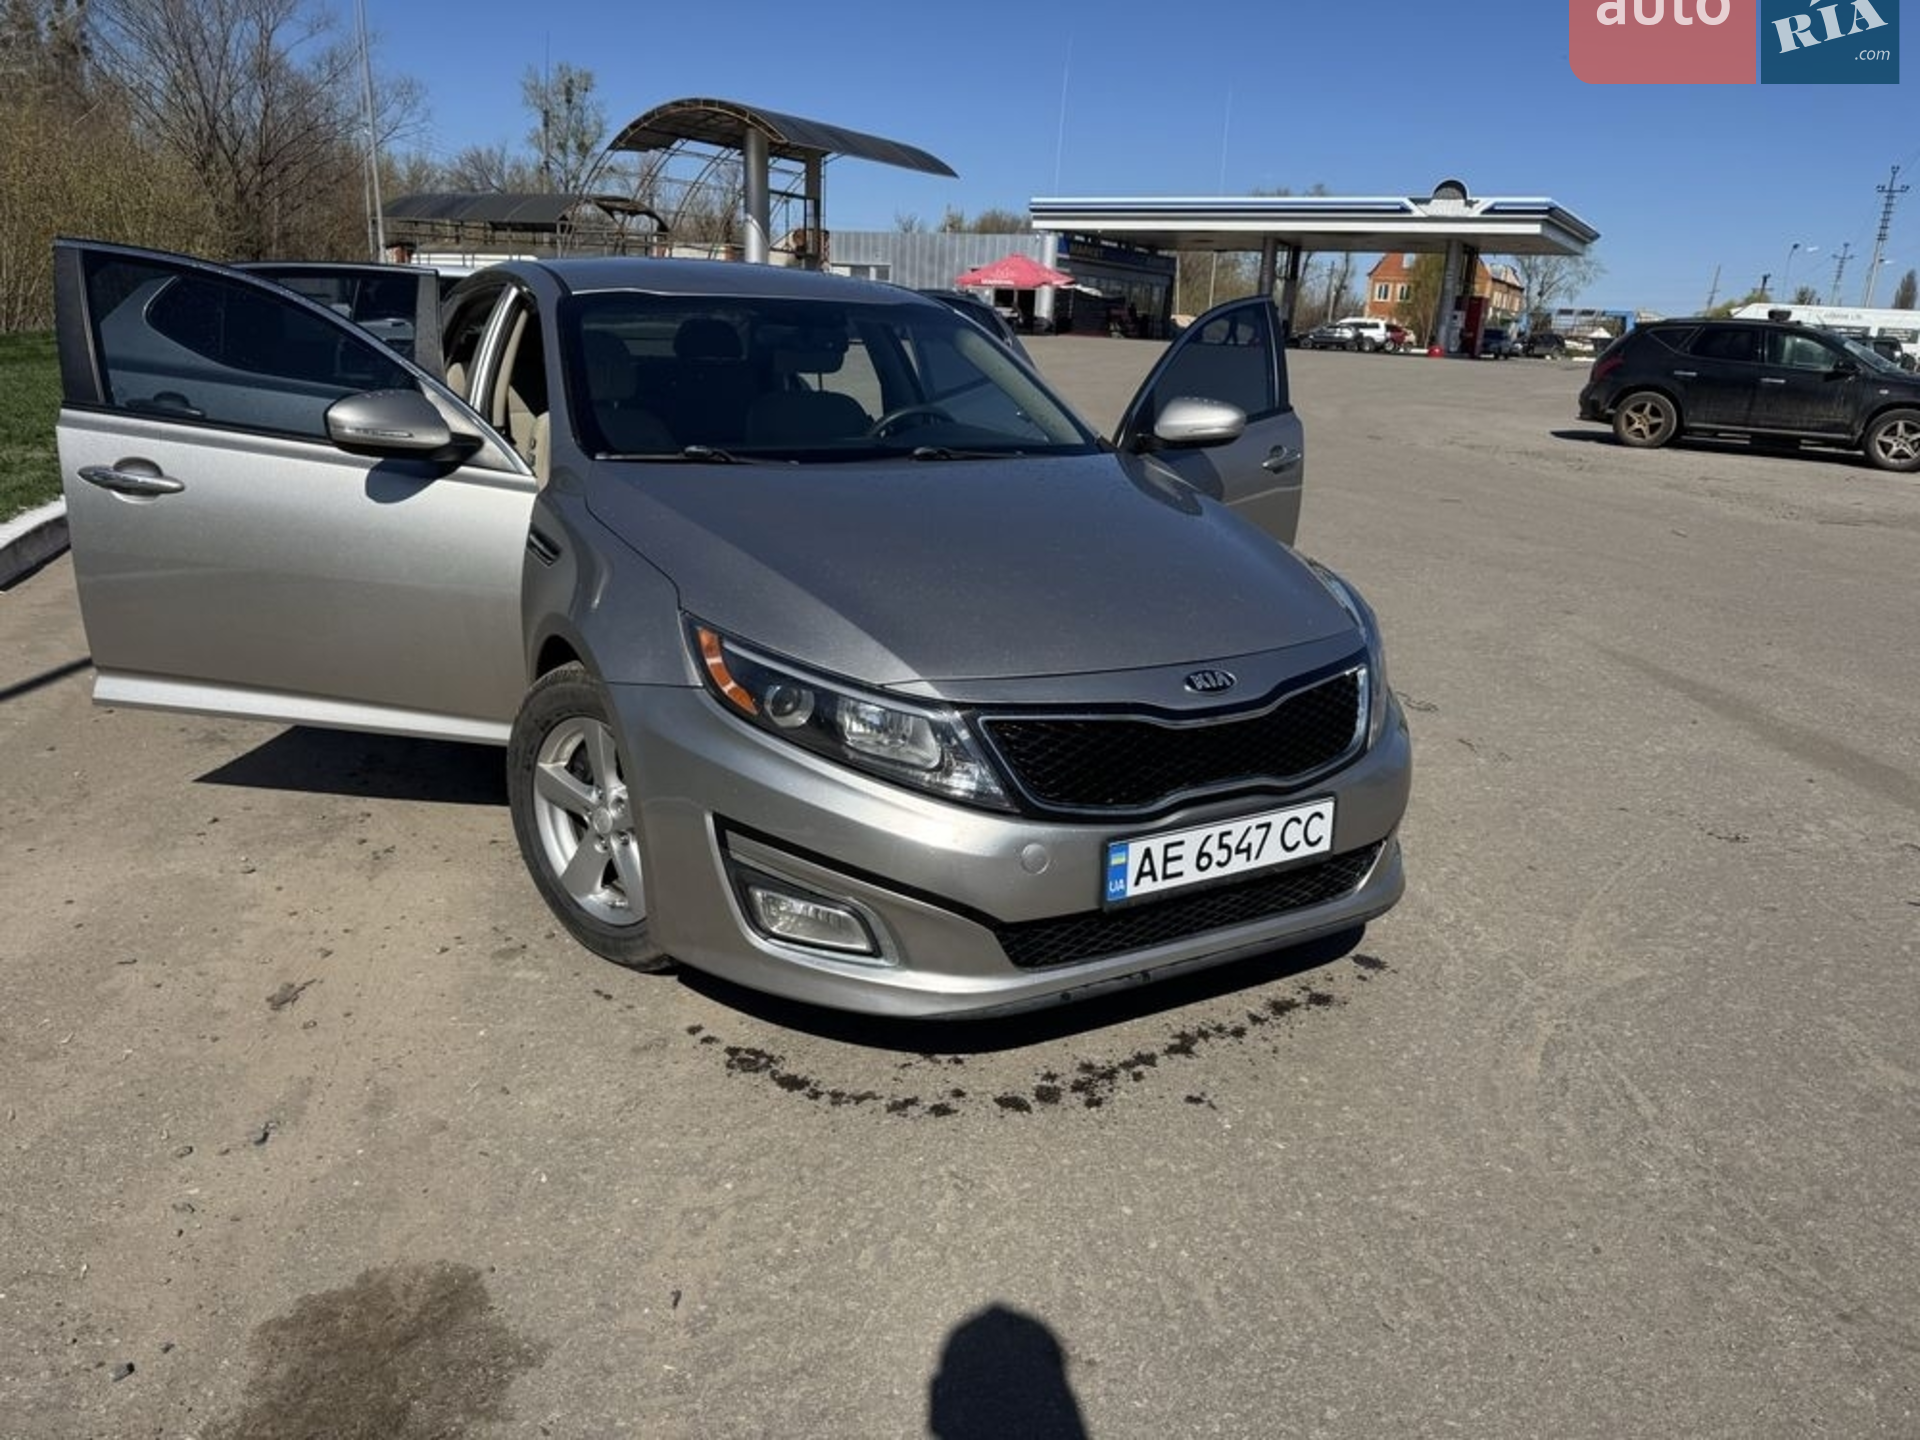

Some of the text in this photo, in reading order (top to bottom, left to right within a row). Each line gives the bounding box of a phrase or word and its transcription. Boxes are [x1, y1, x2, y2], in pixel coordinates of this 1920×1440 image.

[1190, 671, 1231, 689] KIA
[1134, 811, 1325, 886] AE 6547 CC
[1109, 881, 1125, 892] UA
